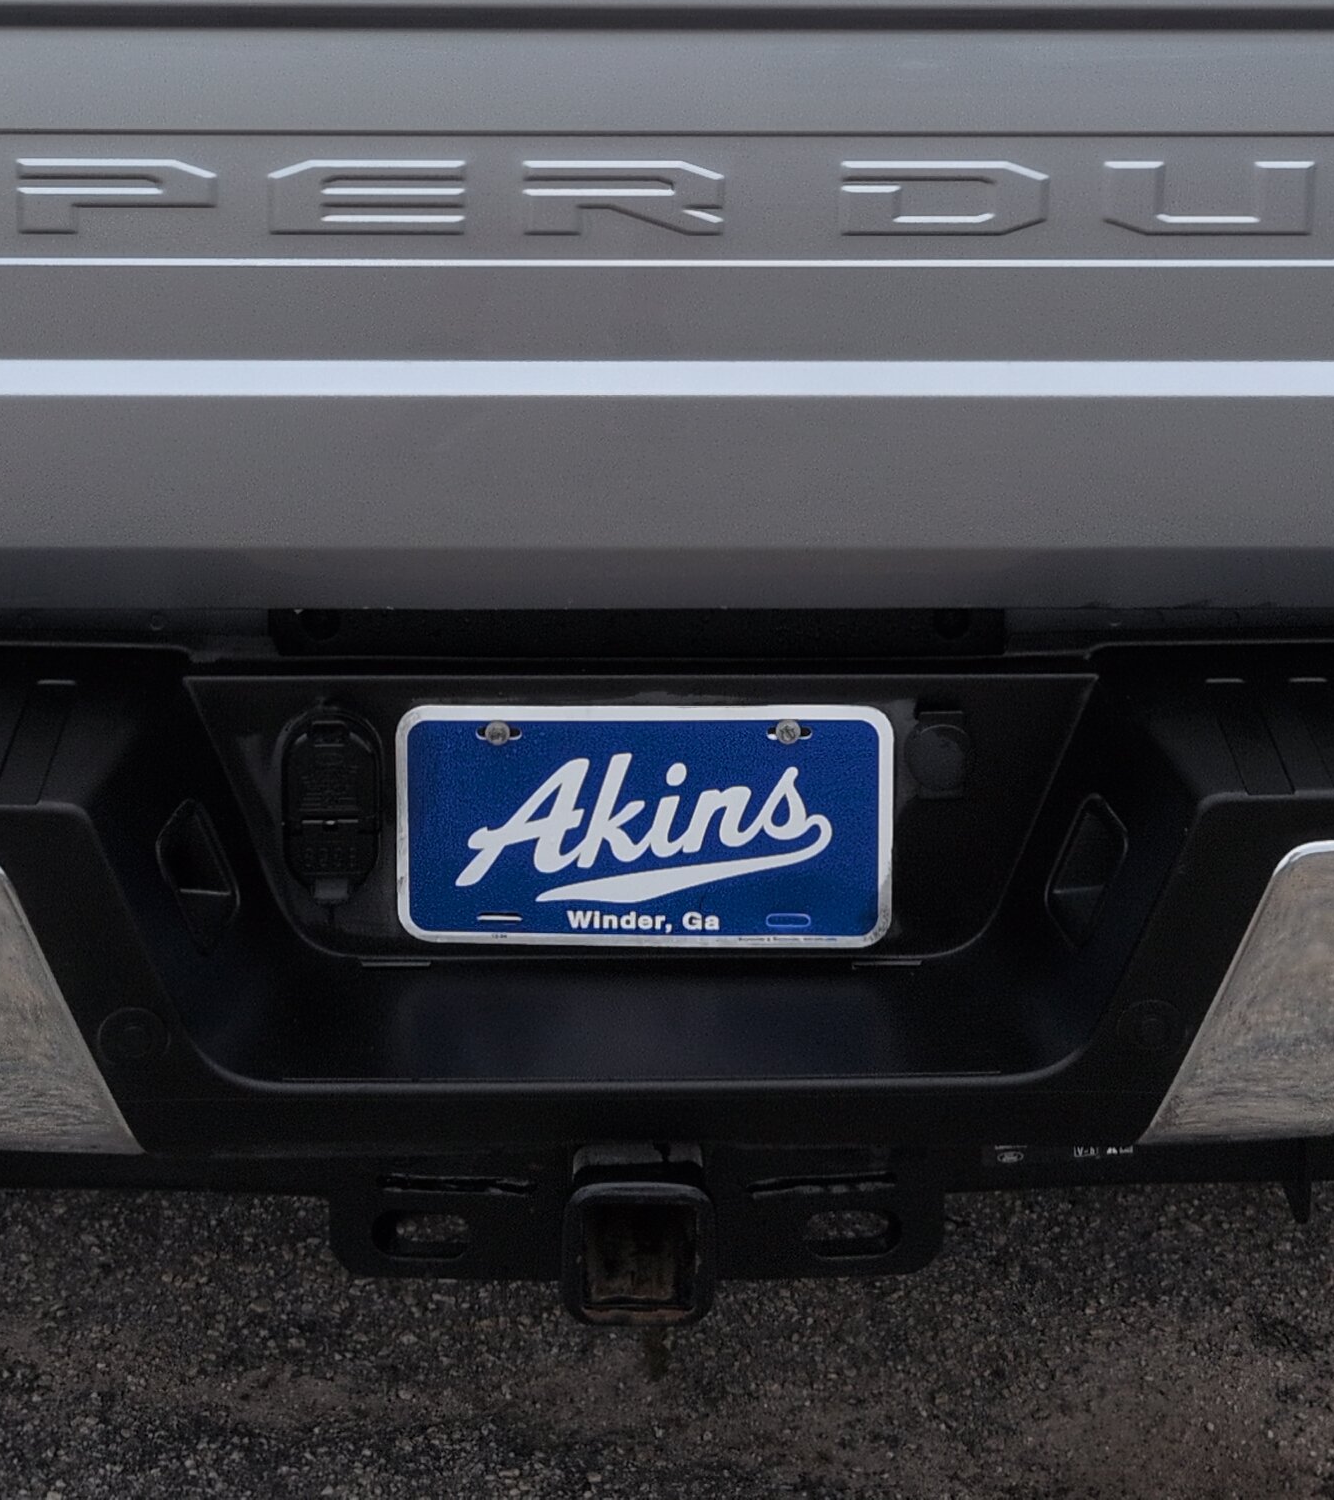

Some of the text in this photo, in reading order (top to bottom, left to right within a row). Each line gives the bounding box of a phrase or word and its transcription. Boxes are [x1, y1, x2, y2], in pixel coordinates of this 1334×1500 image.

[455, 752, 833, 904] Akins
[566, 910, 721, 934] Winder, Ga
